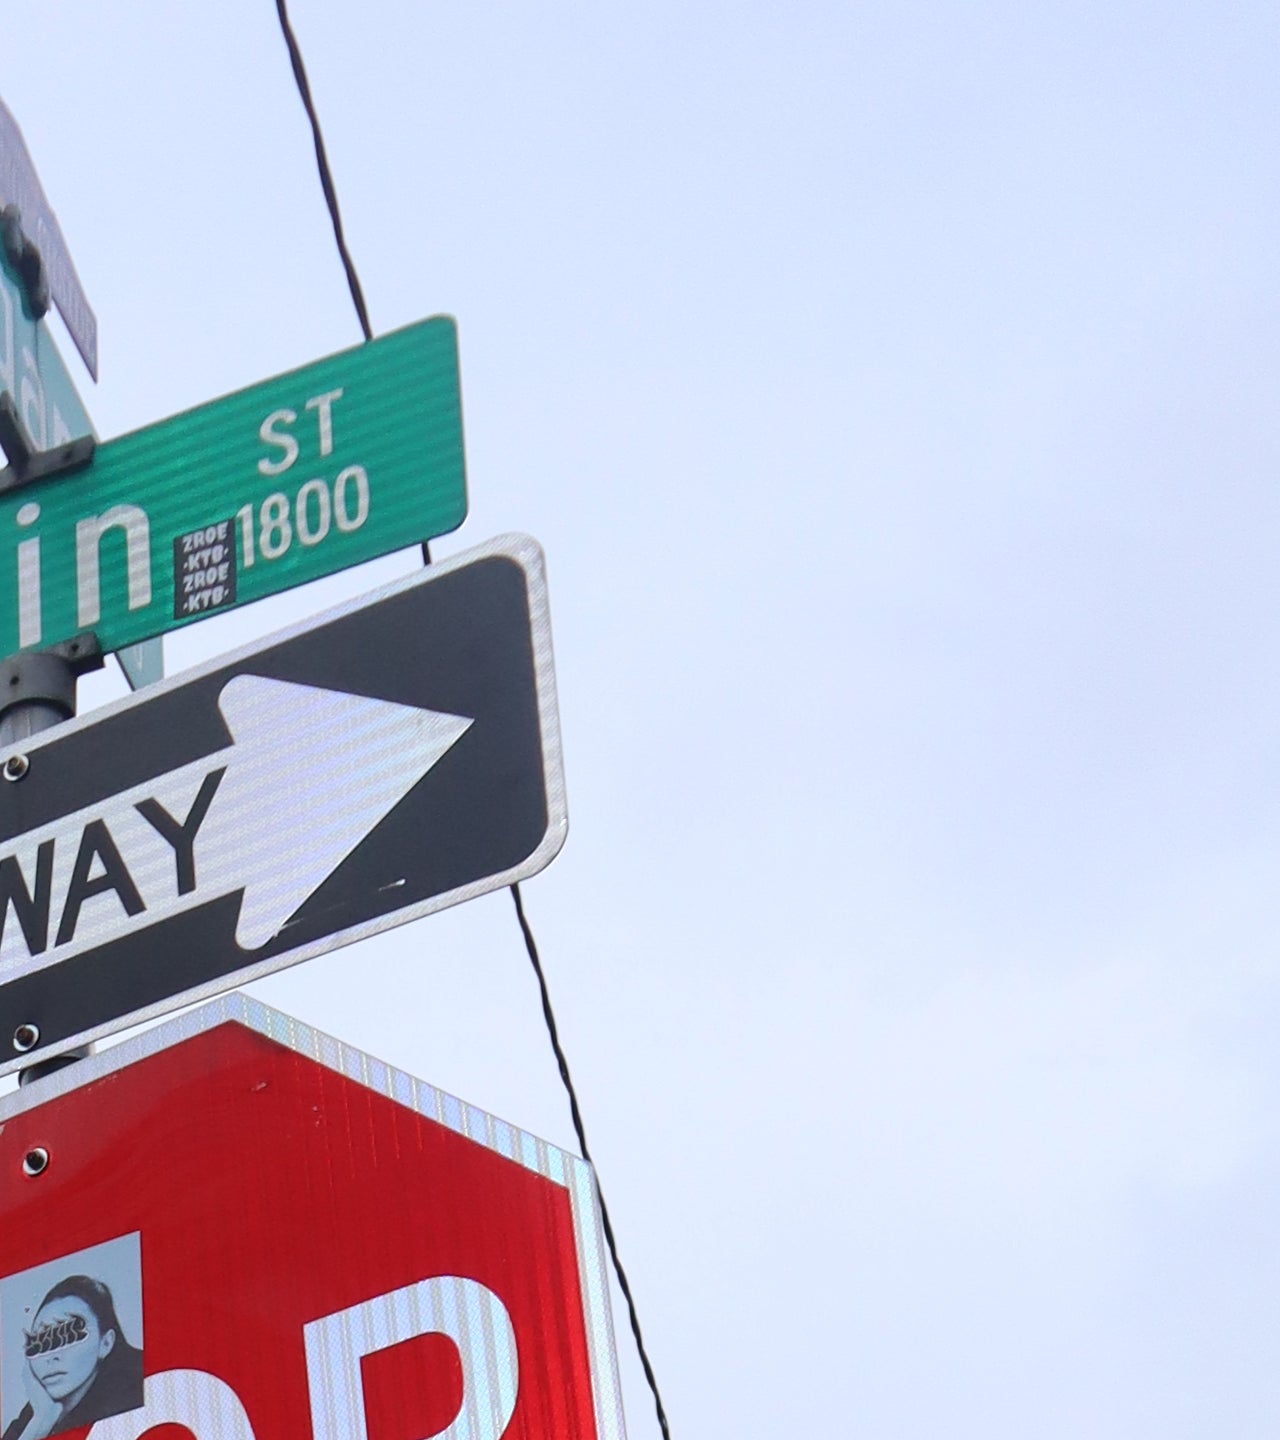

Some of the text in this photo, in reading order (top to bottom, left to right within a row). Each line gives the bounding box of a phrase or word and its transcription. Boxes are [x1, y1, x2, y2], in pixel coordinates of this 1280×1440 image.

[257, 388, 345, 476] ST
[182, 521, 229, 553] ZROE
[237, 464, 370, 568] 1800
[182, 561, 230, 593] ZROE
